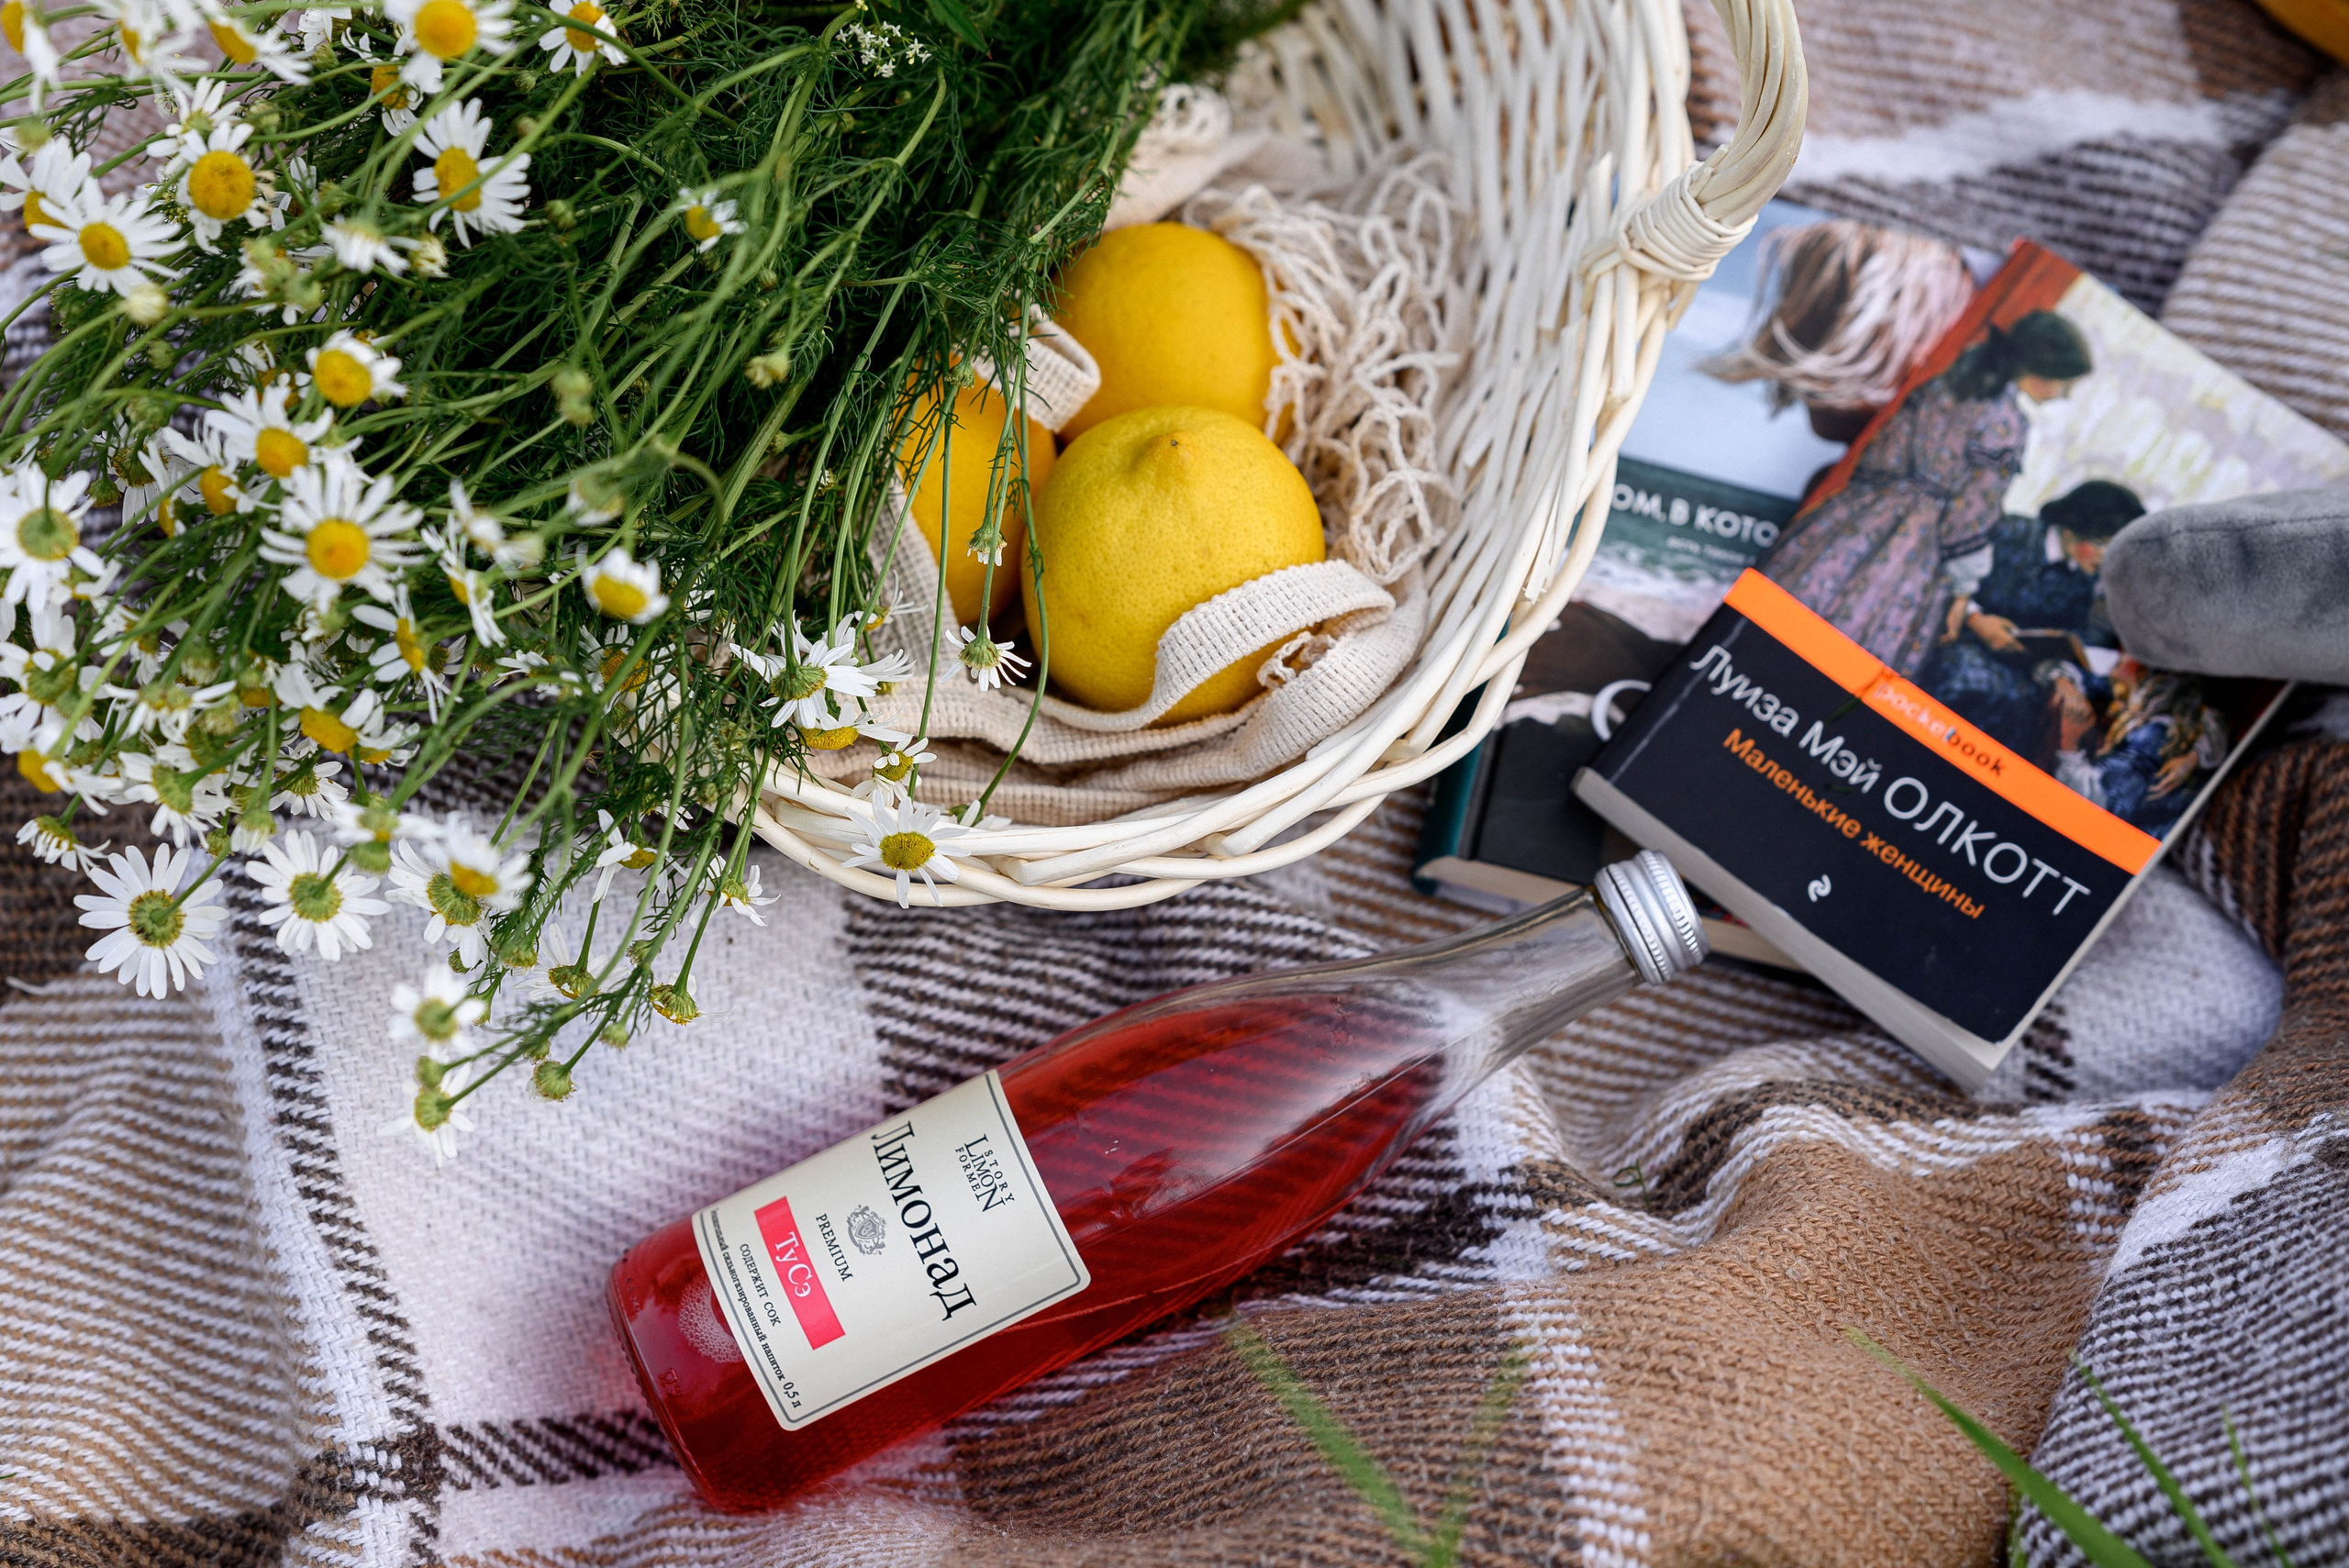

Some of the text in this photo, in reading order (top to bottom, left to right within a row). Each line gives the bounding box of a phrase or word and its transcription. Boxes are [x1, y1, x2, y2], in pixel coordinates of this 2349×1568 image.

[1689, 645, 1799, 738] Луиза
[1798, 720, 1882, 794] Мэй
[1883, 777, 2090, 916] ОЛКОТТ
[1722, 728, 1985, 919] Маленькие женщины
[871, 1121, 976, 1321] Лимонад
[964, 1133, 1006, 1212] LIMON
[985, 1150, 1015, 1201] STORY
[740, 1243, 781, 1327] СОДЕРЖИТ СОК
[816, 1213, 853, 1282] PREMIUM
[723, 1251, 802, 1408] сильногазированный напиток 0,5 л
